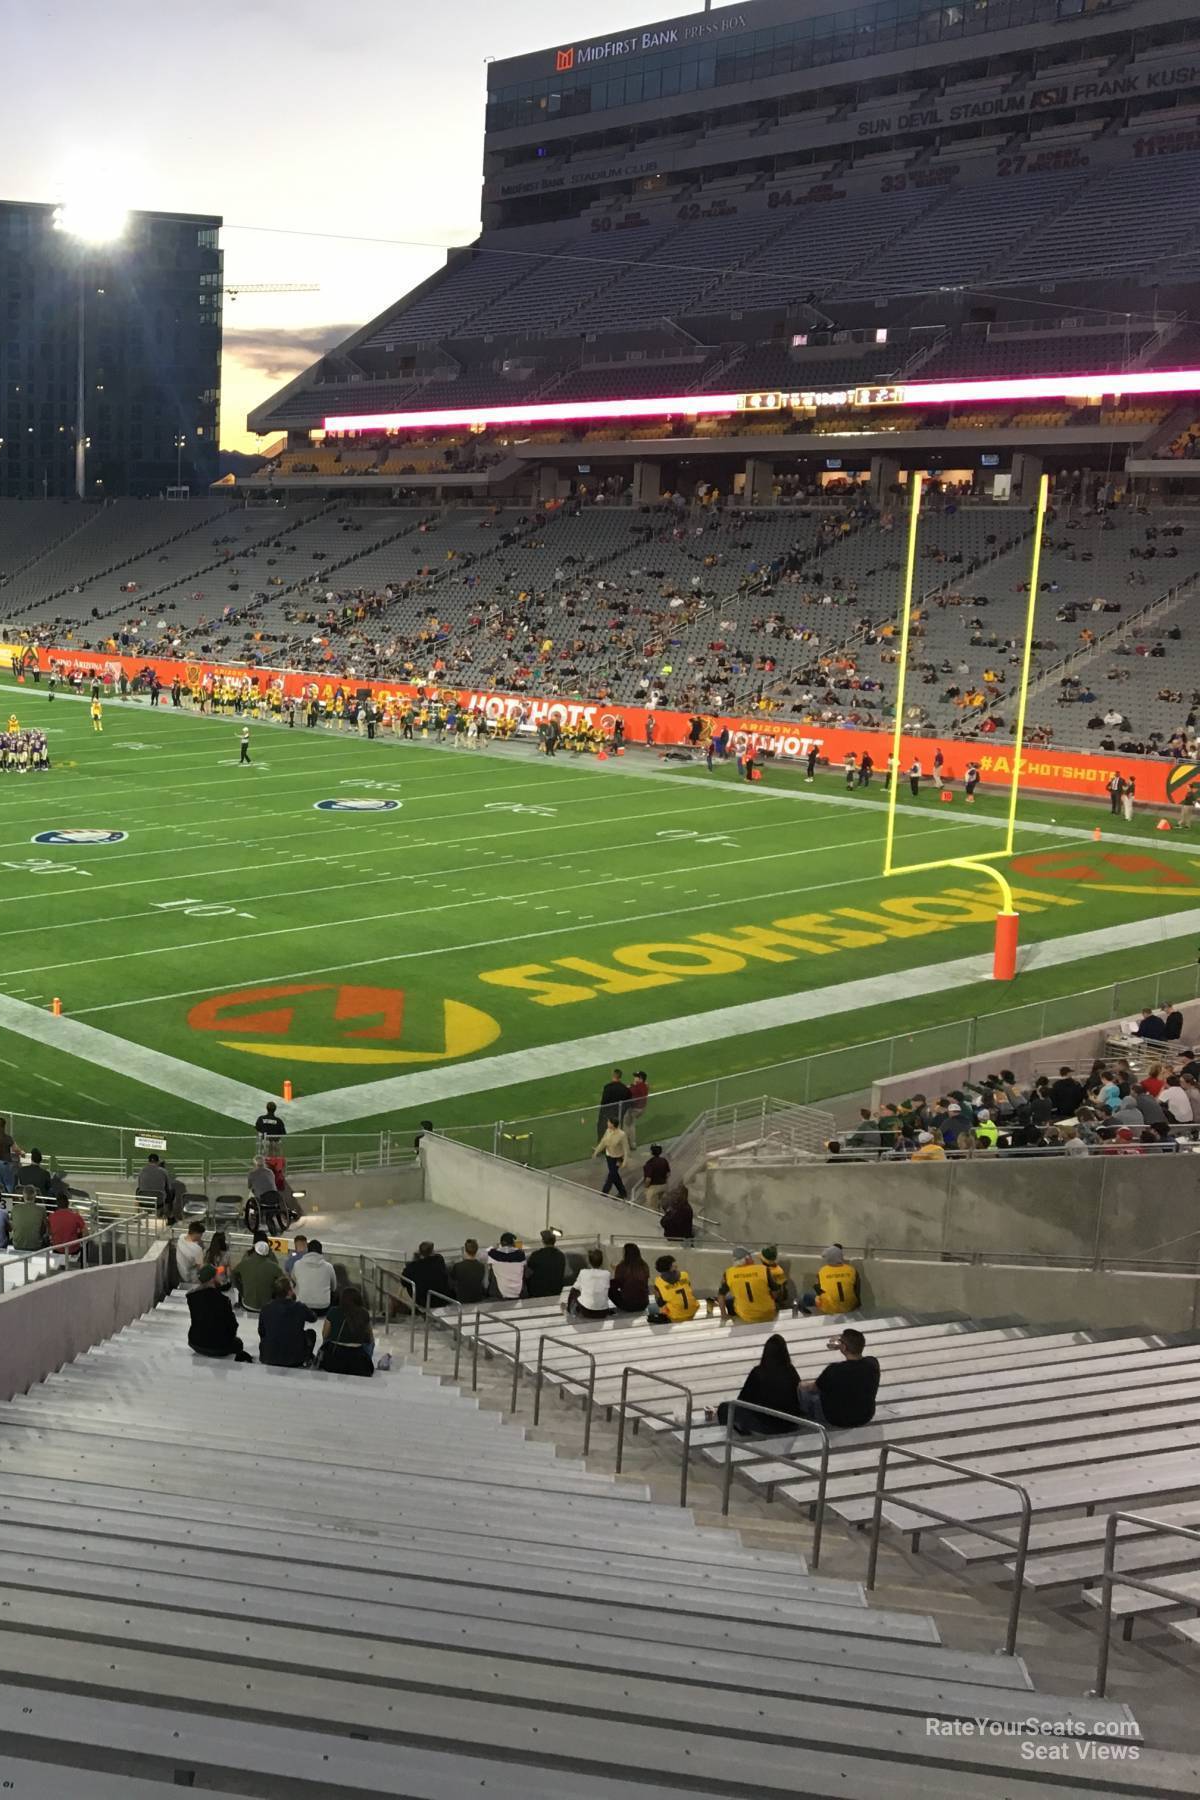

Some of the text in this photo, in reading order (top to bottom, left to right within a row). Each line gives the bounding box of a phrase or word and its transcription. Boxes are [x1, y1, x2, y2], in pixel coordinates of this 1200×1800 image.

[641, 29, 679, 49] BANK
[685, 23, 719, 40] PRESS
[721, 15, 746, 31] BOX
[857, 117, 892, 136] SUN
[898, 109, 943, 129] DEVIL
[950, 95, 1026, 121] STADIUM
[1029, 86, 1069, 110] ASU
[1072, 75, 1140, 101] FRANK
[541, 177, 565, 190] BANK
[571, 167, 623, 184] STADIUM
[625, 161, 658, 176] CLUB
[997, 155, 1026, 177] 27
[880, 174, 907, 192] 33
[768, 190, 793, 209] 84
[676, 203, 700, 221] 42
[591, 217, 612, 234] 50
[740, 723, 800, 735] ARIZONA
[1, 858, 78, 875] 20
[148, 898, 237, 917] 10
[479, 882, 1083, 1006] HOTSHOTS
[675, 1288, 688, 1309] 7
[745, 1281, 753, 1303] 1
[837, 1281, 845, 1303] 1
